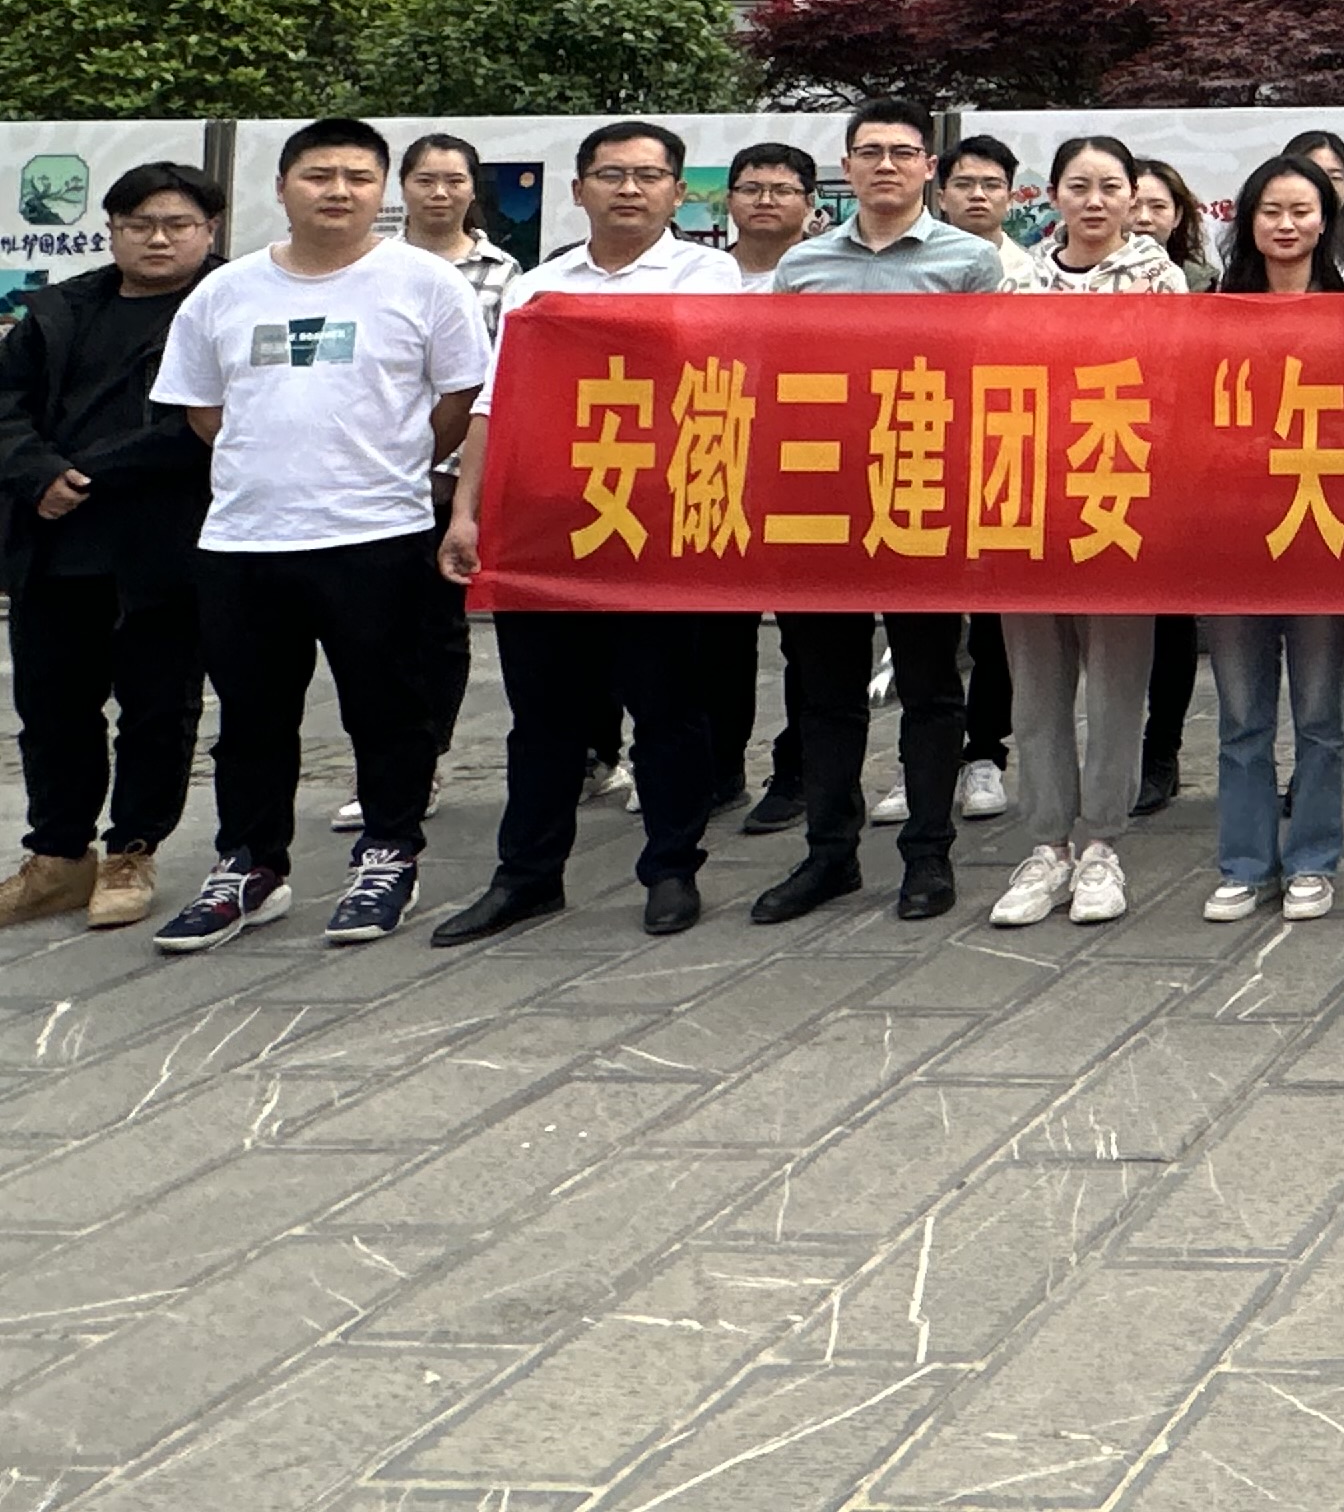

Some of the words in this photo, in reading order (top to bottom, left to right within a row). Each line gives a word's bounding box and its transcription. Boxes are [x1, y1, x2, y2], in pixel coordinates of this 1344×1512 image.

[569, 355, 1150, 563] 安徽三建团委
